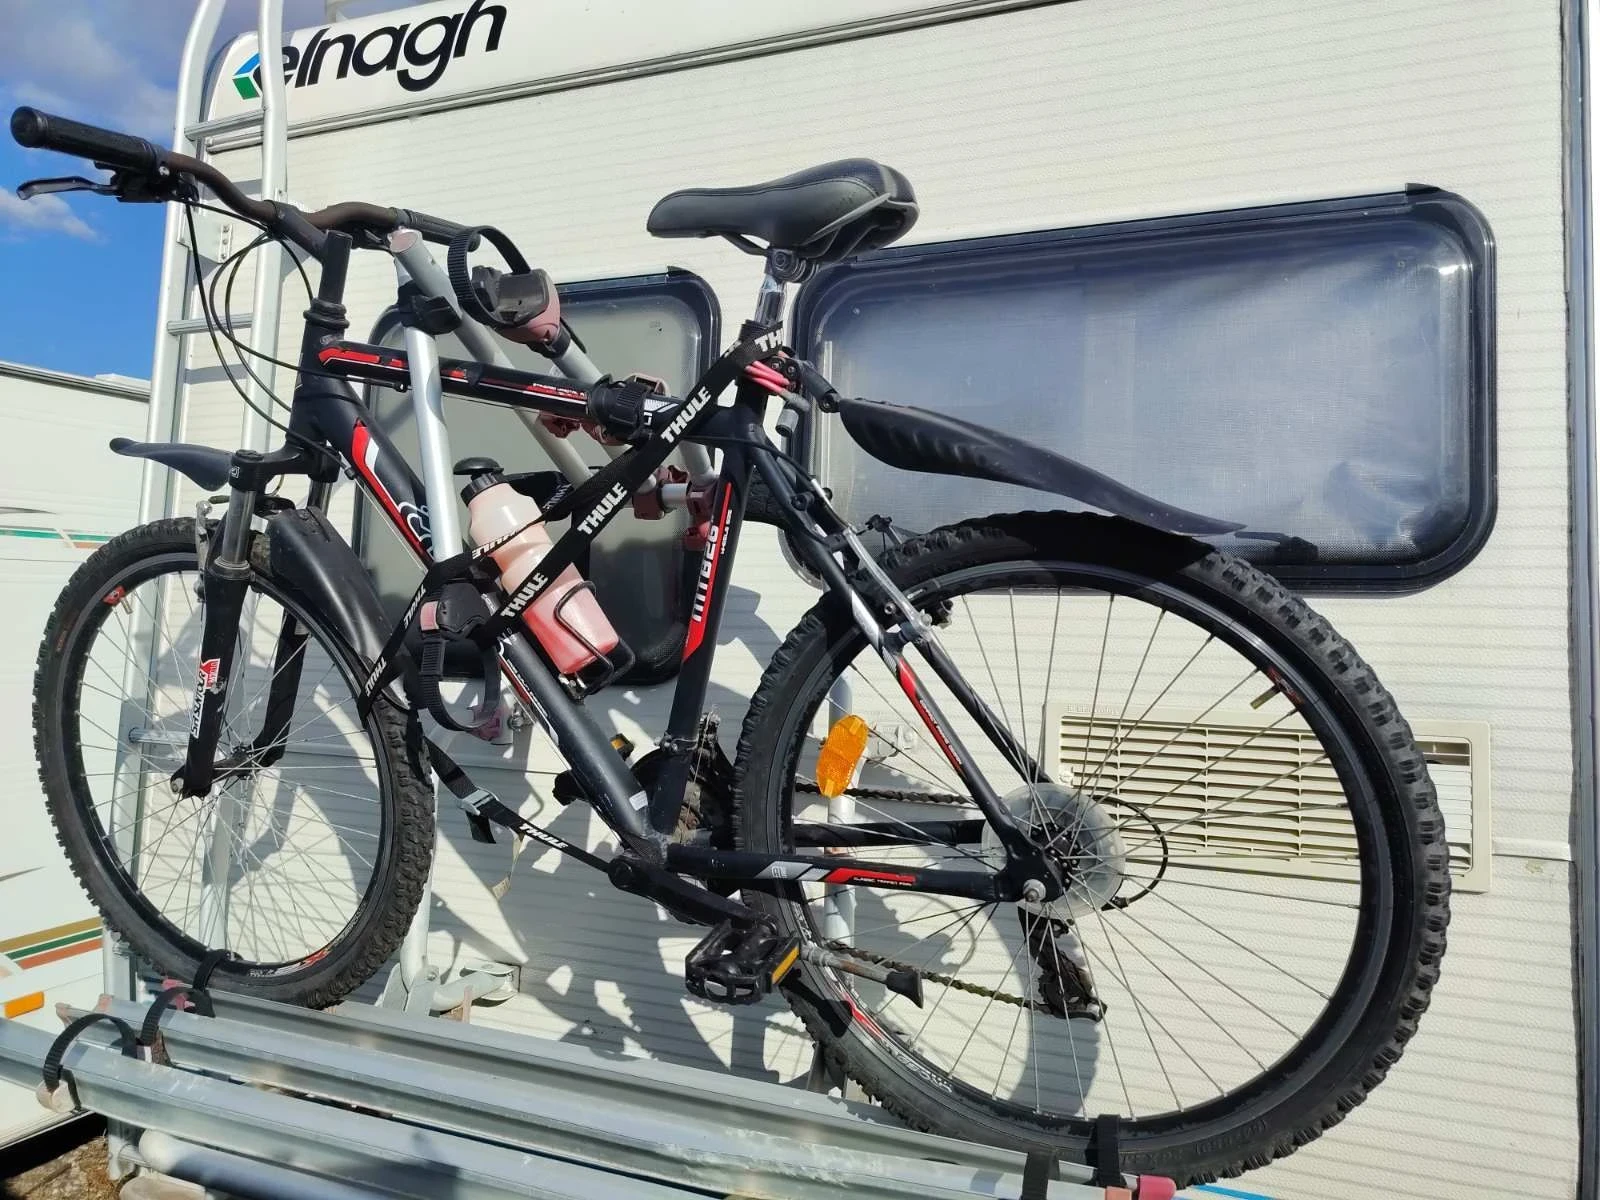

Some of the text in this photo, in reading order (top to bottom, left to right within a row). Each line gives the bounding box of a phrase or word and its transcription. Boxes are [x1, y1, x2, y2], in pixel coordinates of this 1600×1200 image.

[661, 386, 711, 443] THULE
[577, 481, 628, 536] THULE
[404, 584, 426, 629] THULE
[501, 572, 549, 618] THULE
[365, 658, 387, 697] THULE
[519, 823, 569, 849] THULE
